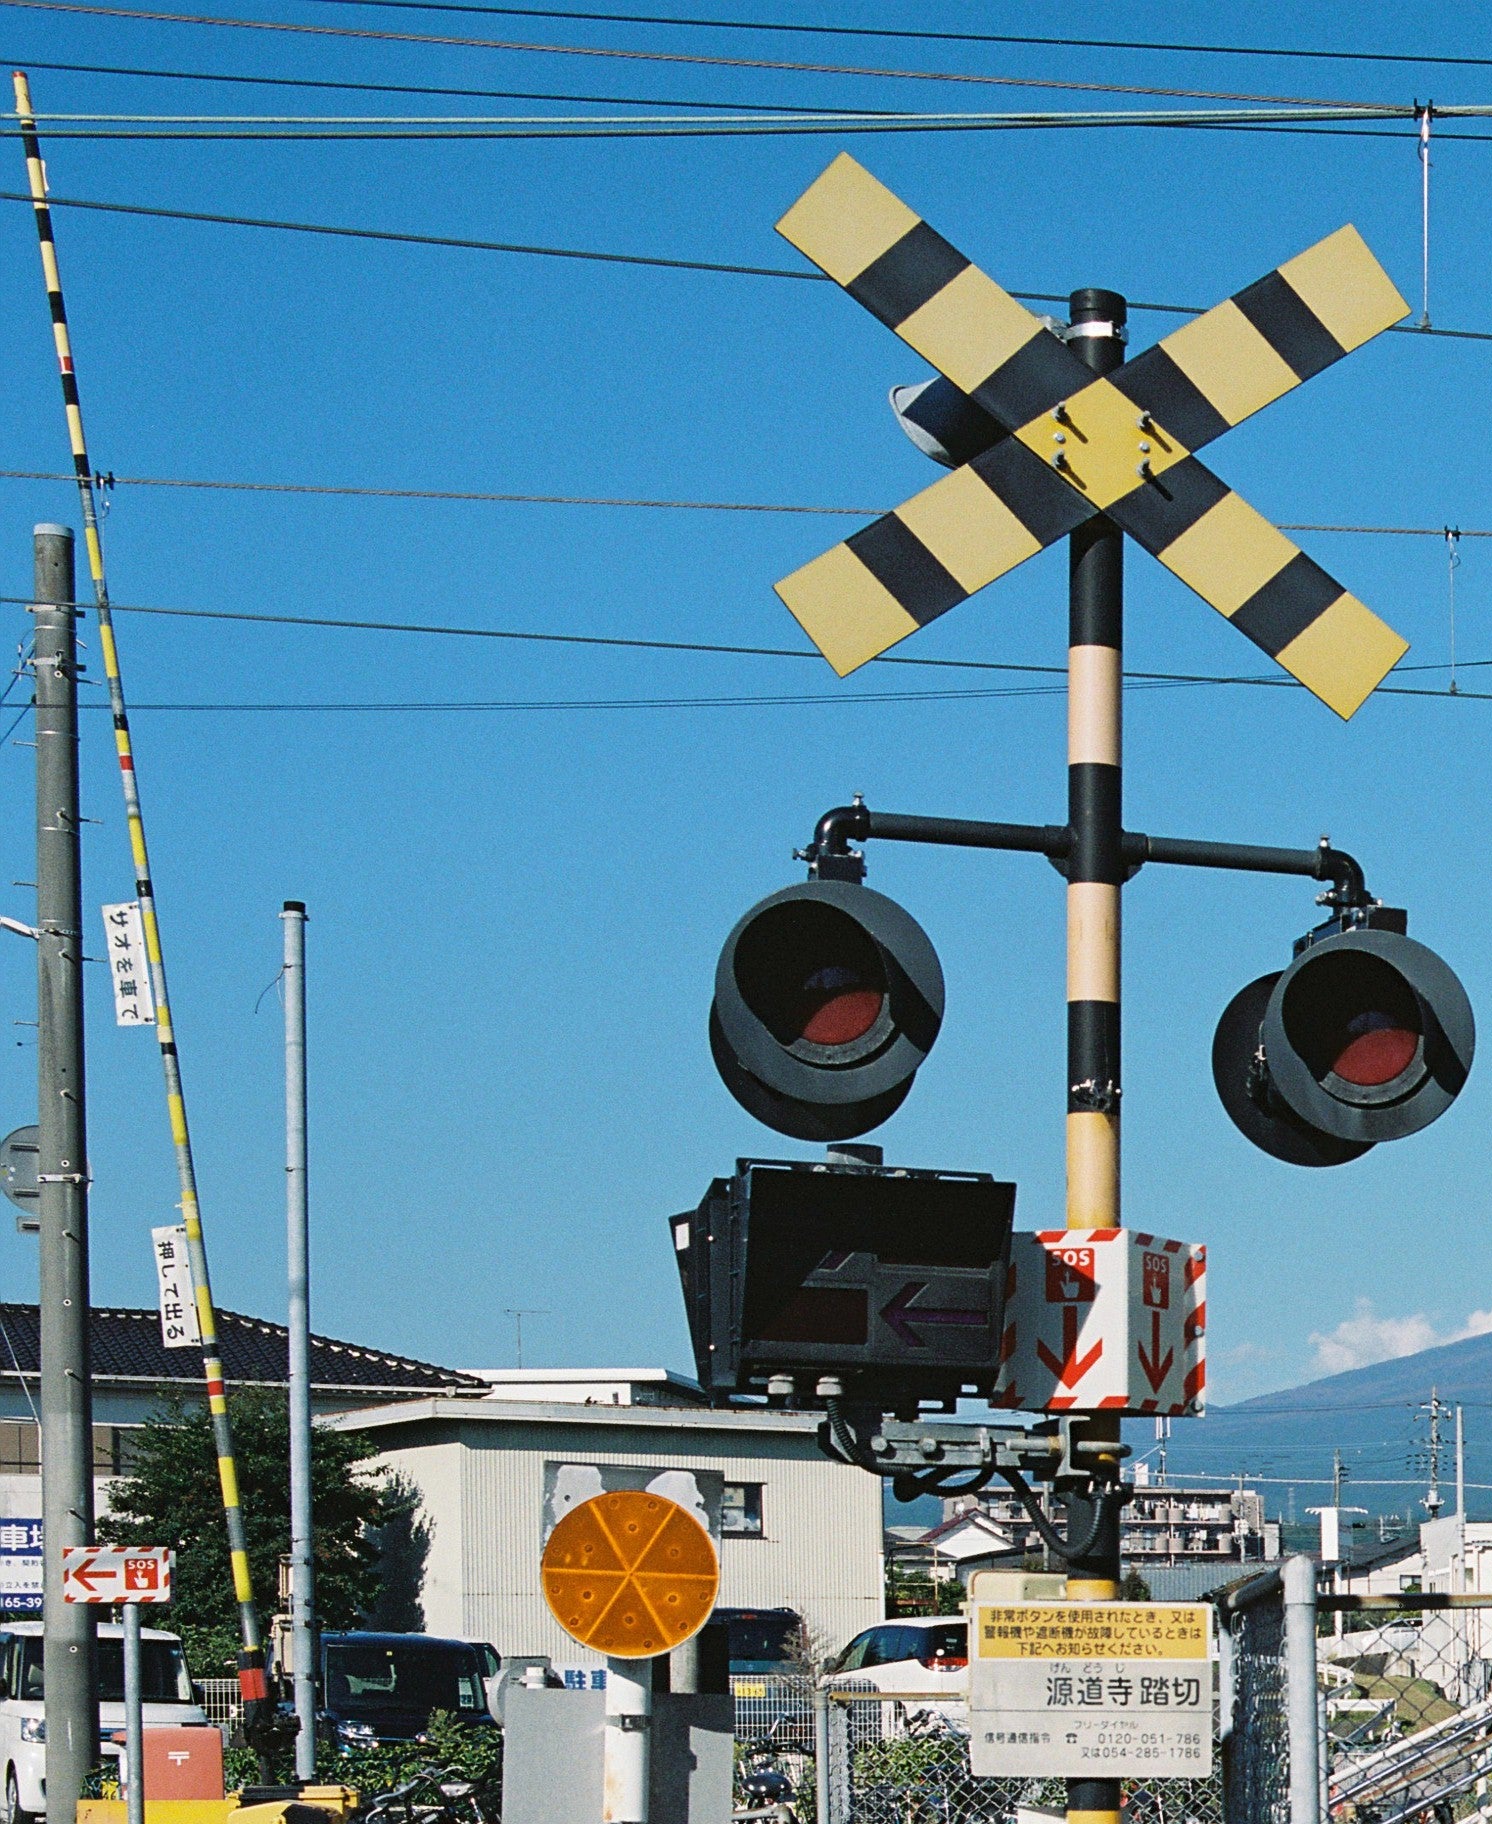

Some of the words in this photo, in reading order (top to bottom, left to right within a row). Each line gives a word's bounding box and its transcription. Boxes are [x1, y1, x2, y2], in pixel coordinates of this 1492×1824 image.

[109, 910, 139, 1020] サオを車で
[1051, 1249, 1091, 1267] SOS
[1145, 1254, 1168, 1274] SOS
[158, 1240, 185, 1340] 押して出る
[128, 1559, 155, 1570] SOS
[990, 1609, 1196, 1624] 非常ボタンを使用されたとき、又は
[984, 1625, 1202, 1640] 警報機や遮断機が故障しているときは
[1017, 1641, 1164, 1656] 下記へお知らせください。
[1046, 1676, 1201, 1707] 源道寺踏切
[1073, 1720, 1139, 1730] フリーダイヤル
[984, 1732, 1051, 1744] 信号通信指令
[1097, 1733, 1201, 1745] 0120-051-786
